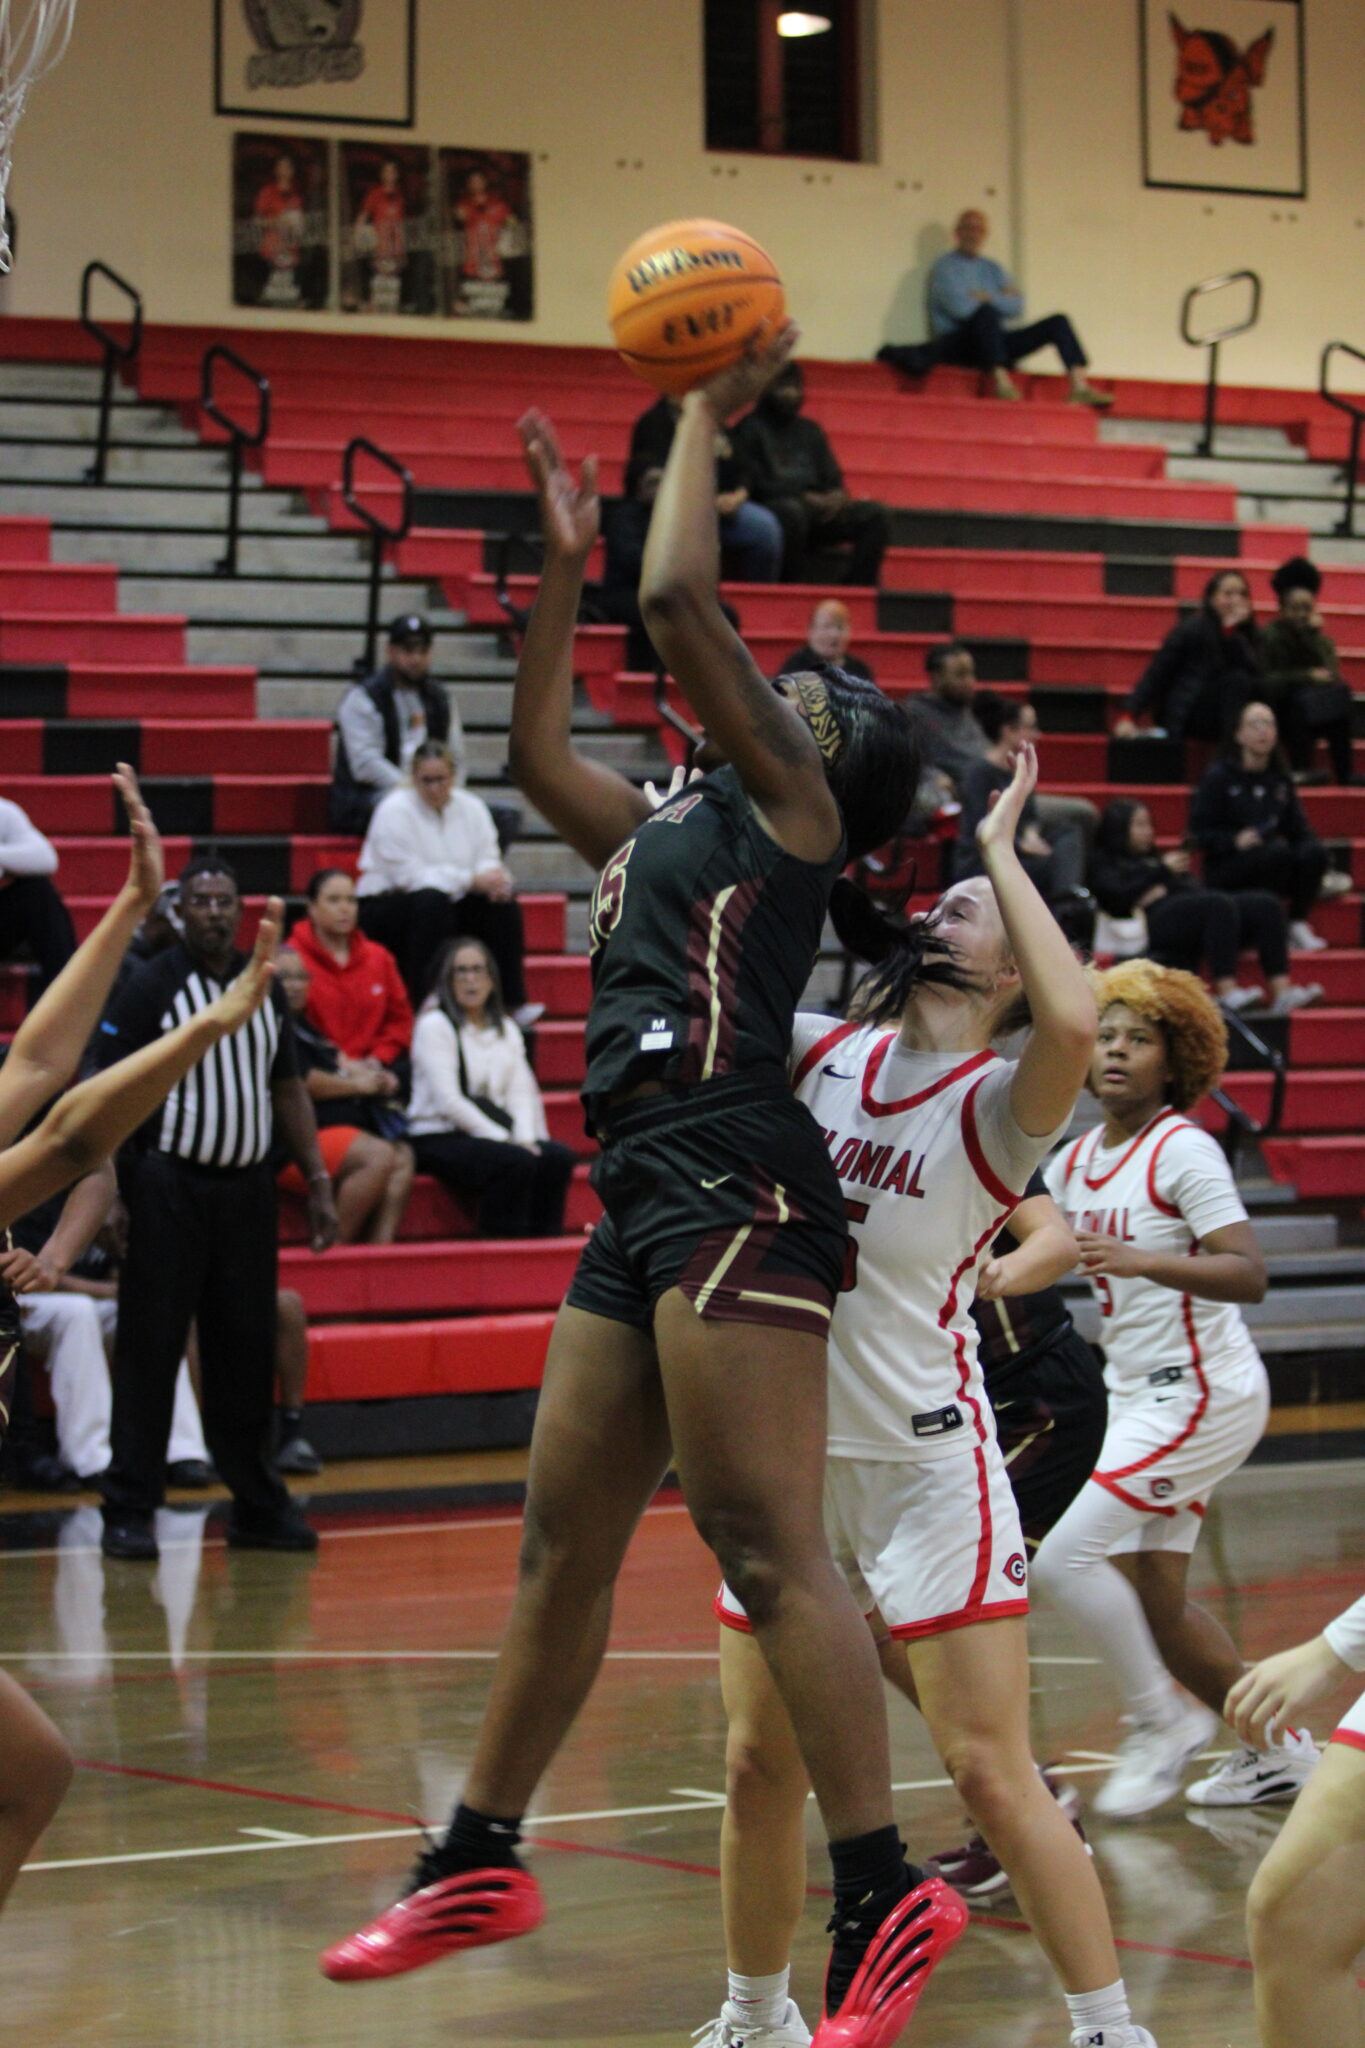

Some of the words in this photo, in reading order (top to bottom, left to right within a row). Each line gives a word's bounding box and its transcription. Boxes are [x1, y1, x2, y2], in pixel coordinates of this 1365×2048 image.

[652, 1018, 666, 1031] M
[821, 1127, 926, 1199] ONIAL
[945, 1411, 957, 1424] M
